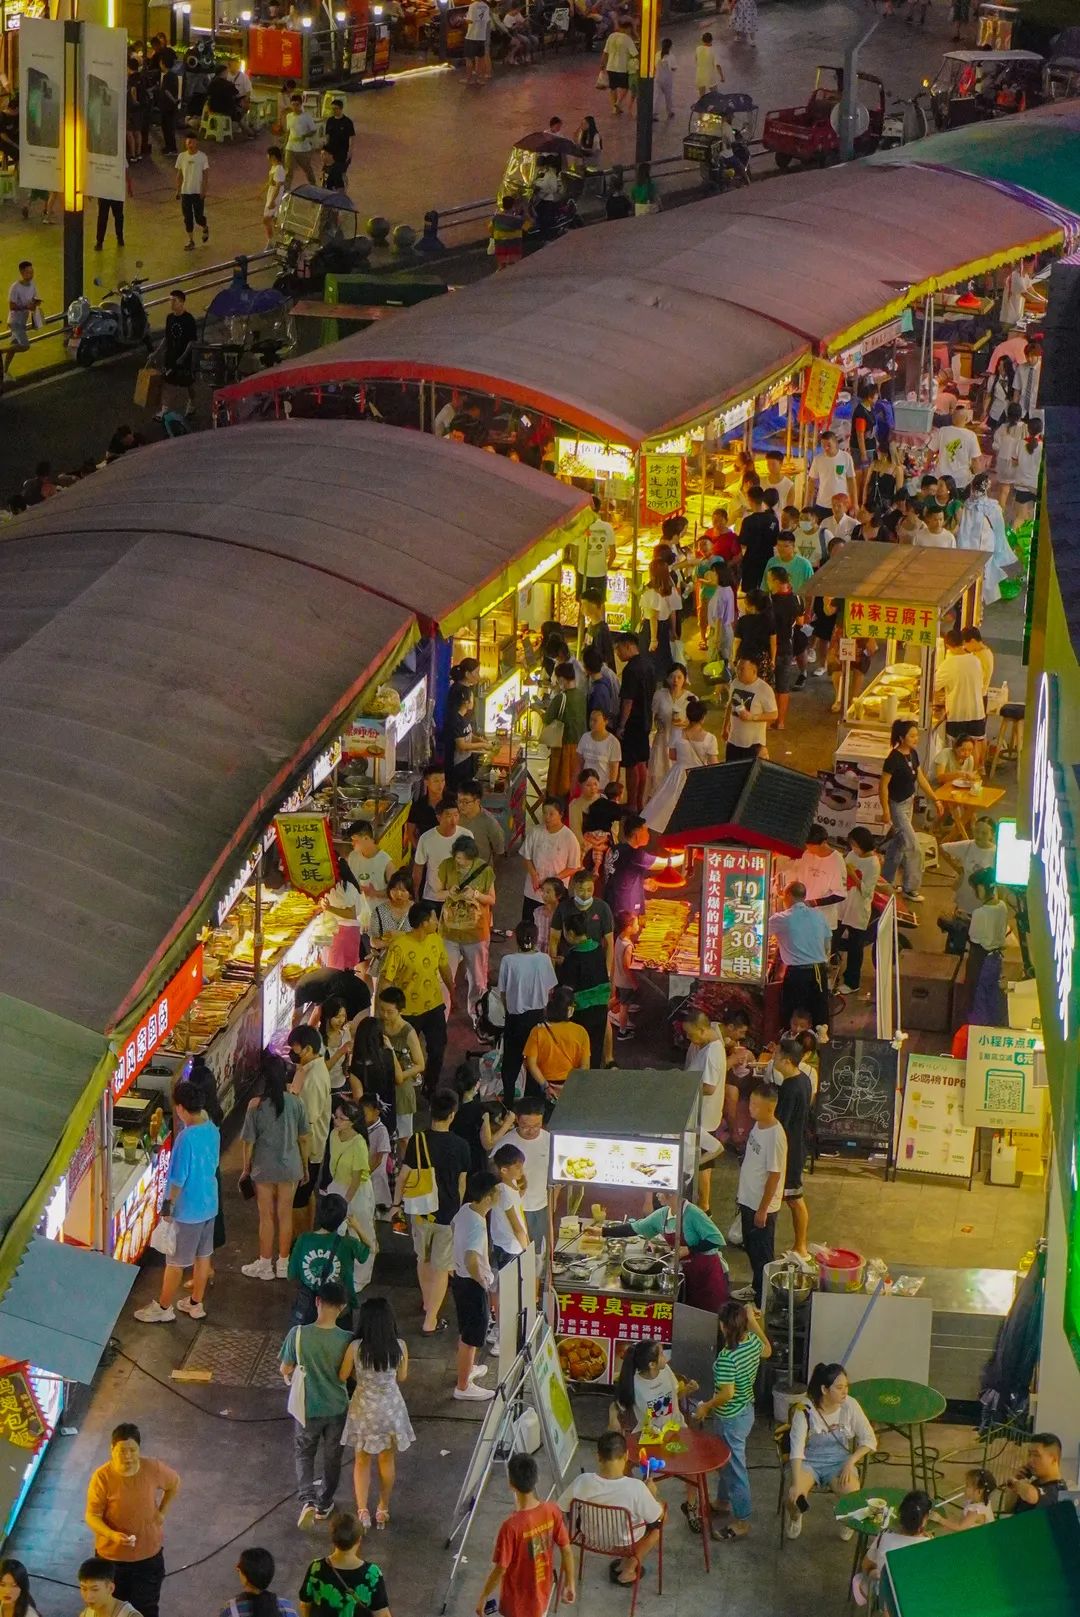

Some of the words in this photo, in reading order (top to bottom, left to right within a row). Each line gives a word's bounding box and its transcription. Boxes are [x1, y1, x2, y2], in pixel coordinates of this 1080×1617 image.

[664, 463, 679, 500] 烤扇贝
[850, 602, 933, 628] 林家豆腐干
[850, 623, 932, 645] 天泉井凉糕
[295, 835, 324, 882] 烤生蚝
[708, 852, 765, 872] 夺命小串
[734, 880, 758, 898] 10
[703, 869, 721, 976] 最火爆的网红小吃
[734, 904, 755, 924] 元
[730, 930, 755, 948] 30
[732, 955, 752, 976] 串
[557, 1294, 673, 1320] 千寻臭豆腐
